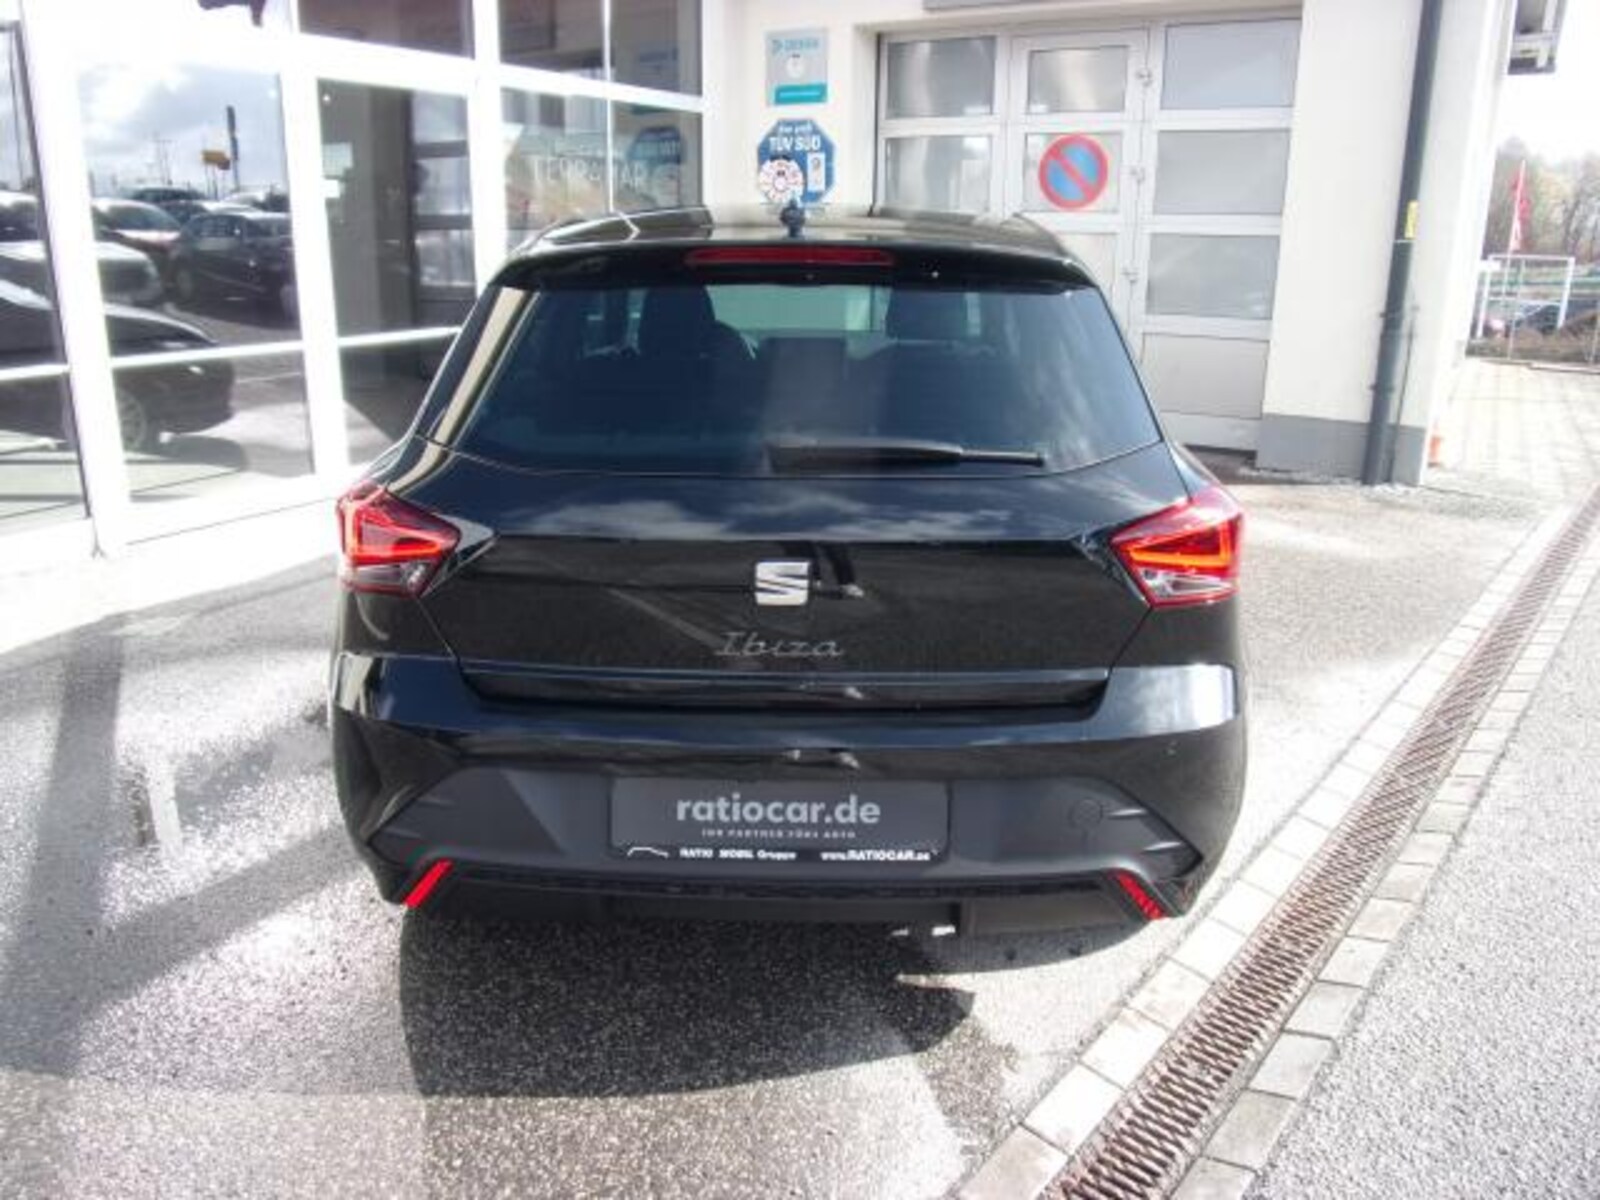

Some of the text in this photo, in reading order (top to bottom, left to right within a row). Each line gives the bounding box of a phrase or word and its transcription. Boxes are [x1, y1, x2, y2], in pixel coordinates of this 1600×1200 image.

[714, 631, 844, 657] Ibiza
[676, 792, 881, 824] ratiocar.de
[679, 847, 714, 859] RATIO
